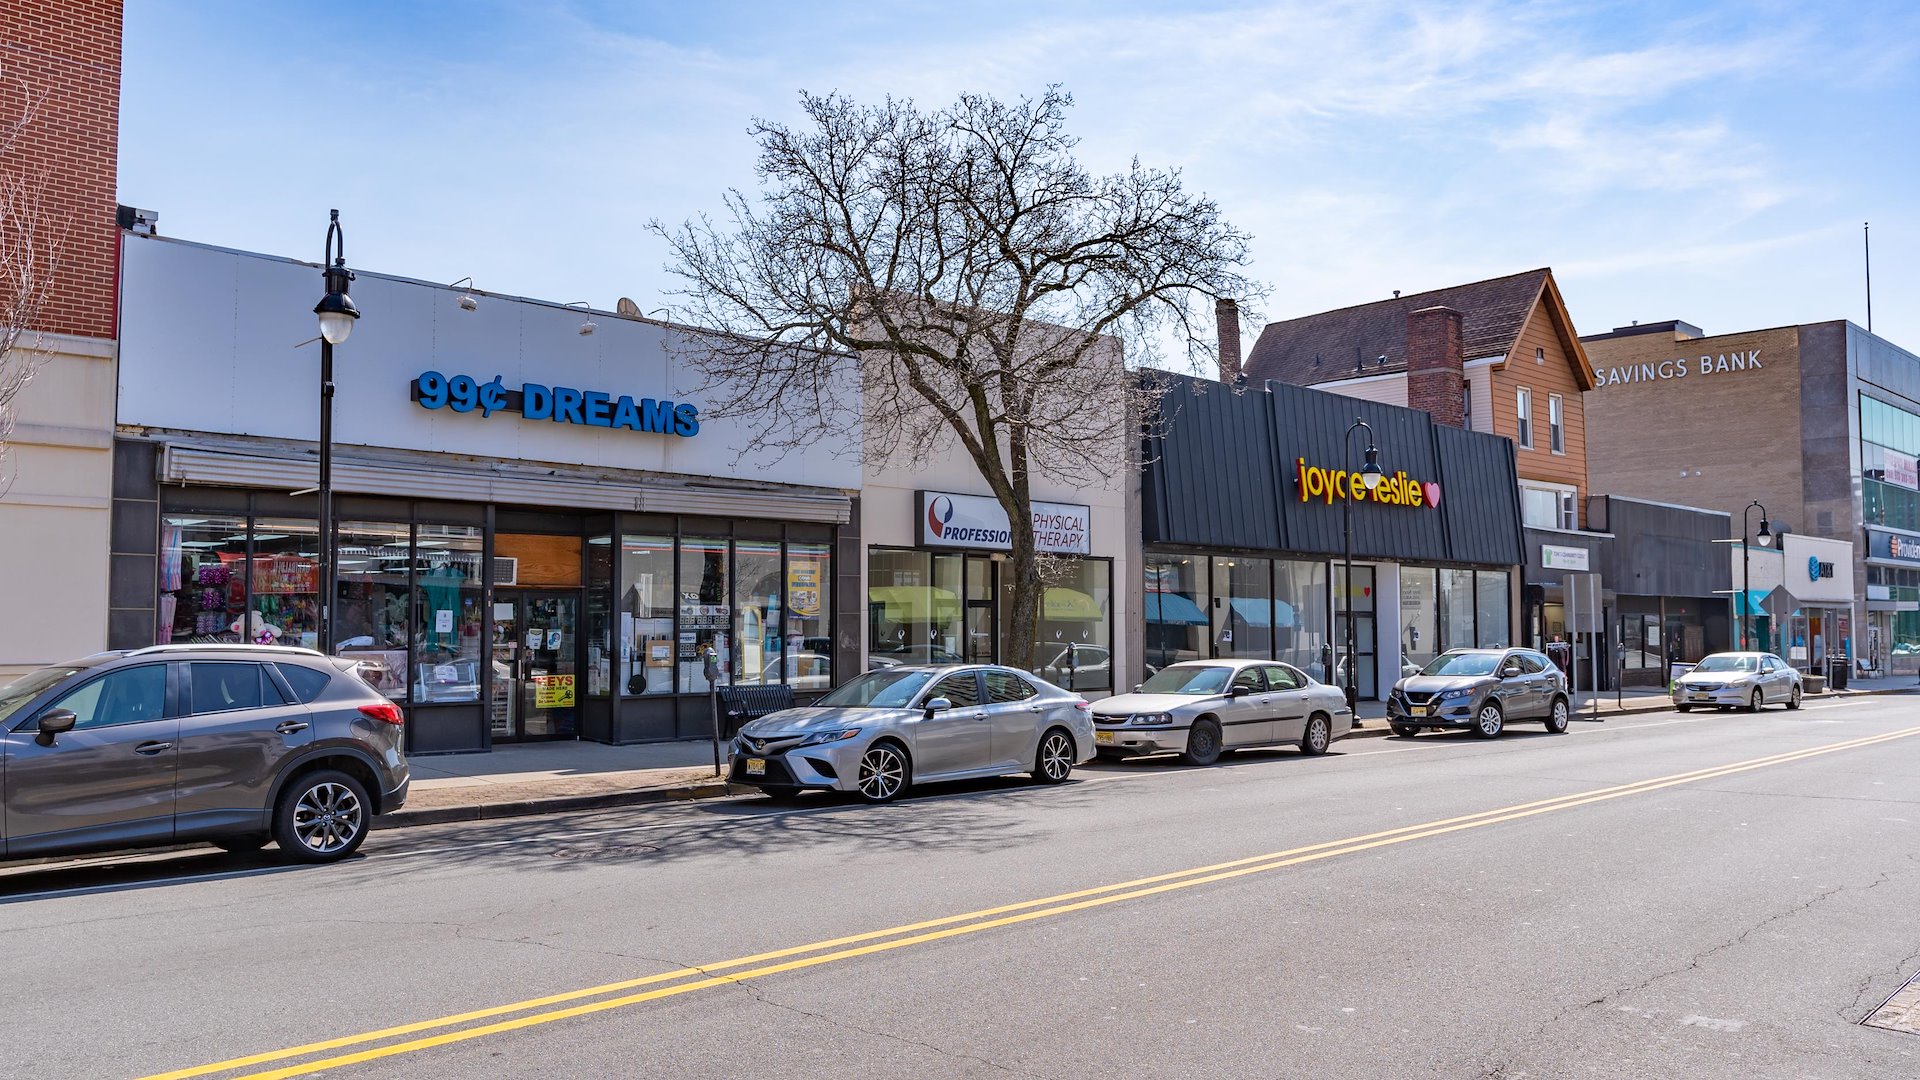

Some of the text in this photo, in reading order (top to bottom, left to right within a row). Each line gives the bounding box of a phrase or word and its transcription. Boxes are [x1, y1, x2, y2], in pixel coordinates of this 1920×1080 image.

[1595, 349, 1764, 387] SAVINGS BANK
[418, 371, 700, 437] 99¢ DREAMS
[1297, 457, 1367, 505] joyce
[1032, 513, 1085, 532] PHYSICAL
[1033, 530, 1084, 548] THERAPY
[1818, 561, 1835, 578] AT&T
